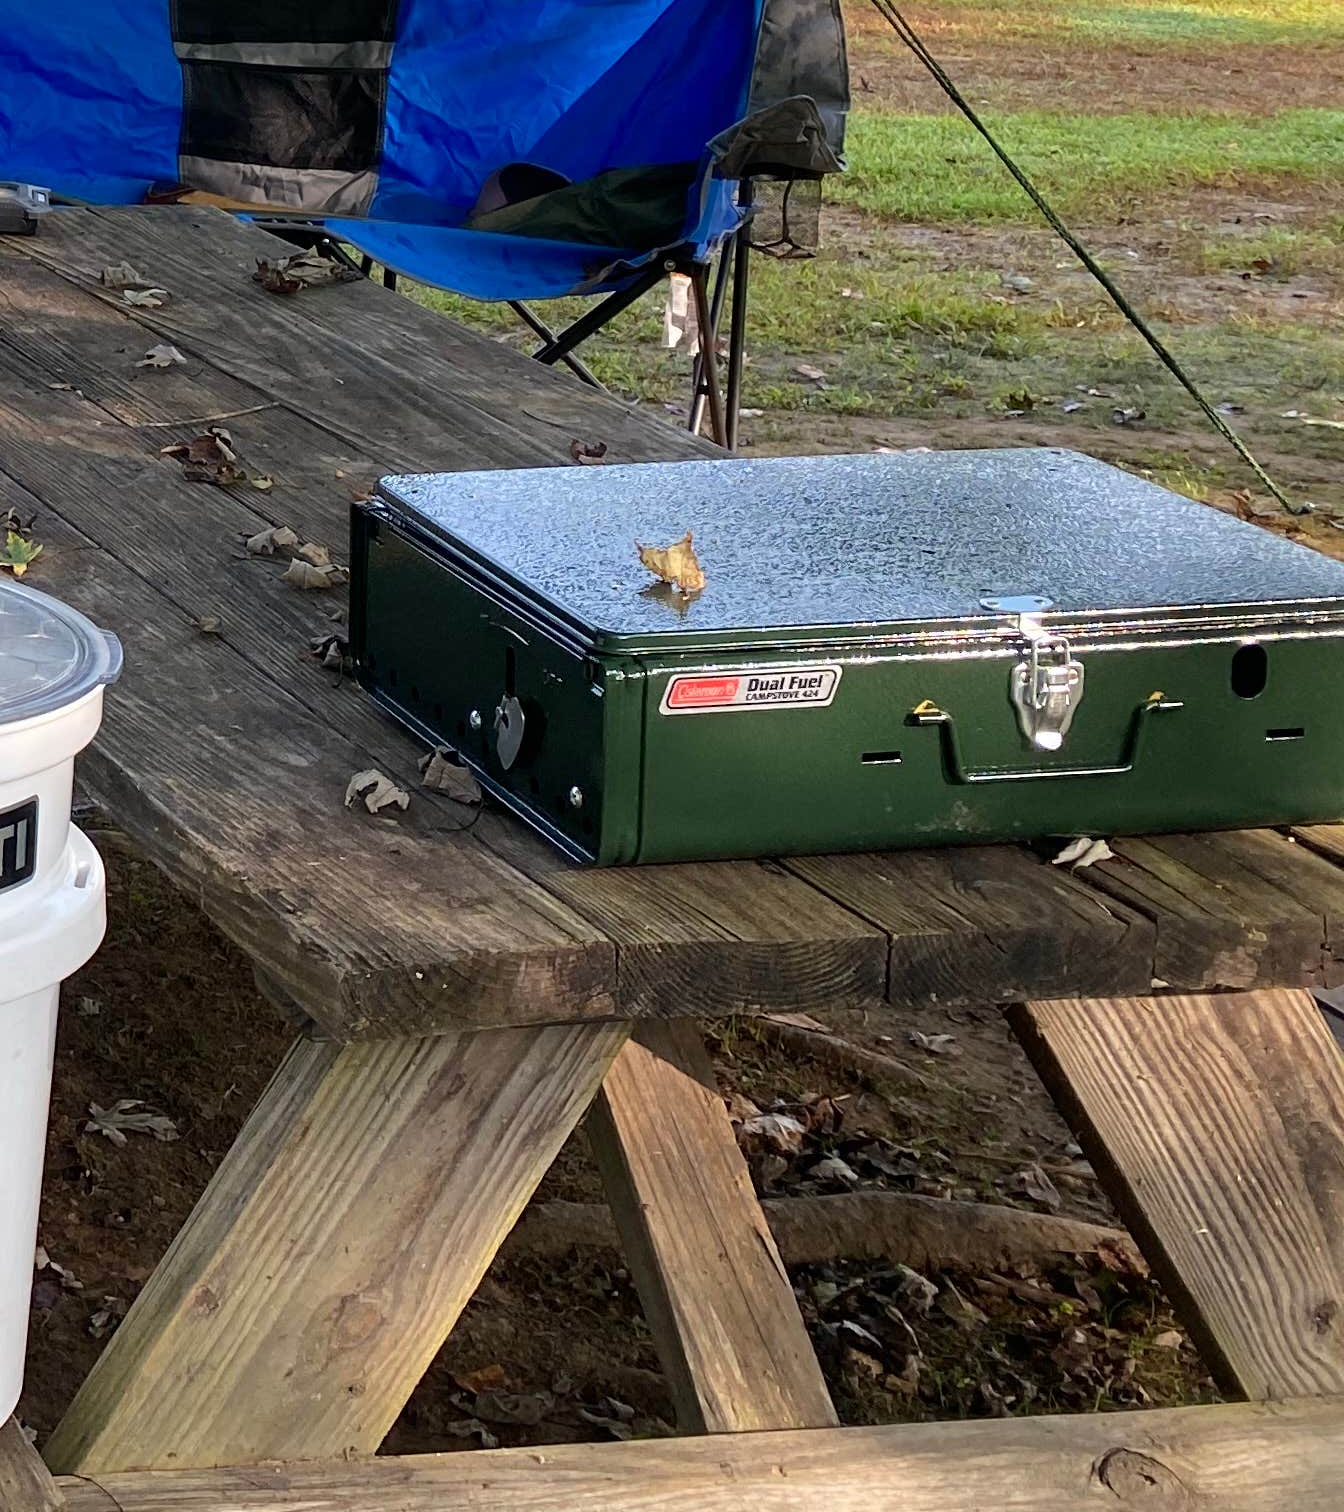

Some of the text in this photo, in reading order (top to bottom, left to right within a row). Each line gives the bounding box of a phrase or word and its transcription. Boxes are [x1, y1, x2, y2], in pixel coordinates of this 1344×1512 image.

[747, 677, 786, 692] Dual
[789, 675, 823, 690] Fuel
[745, 689, 819, 701] CAMPSTOVE 424
